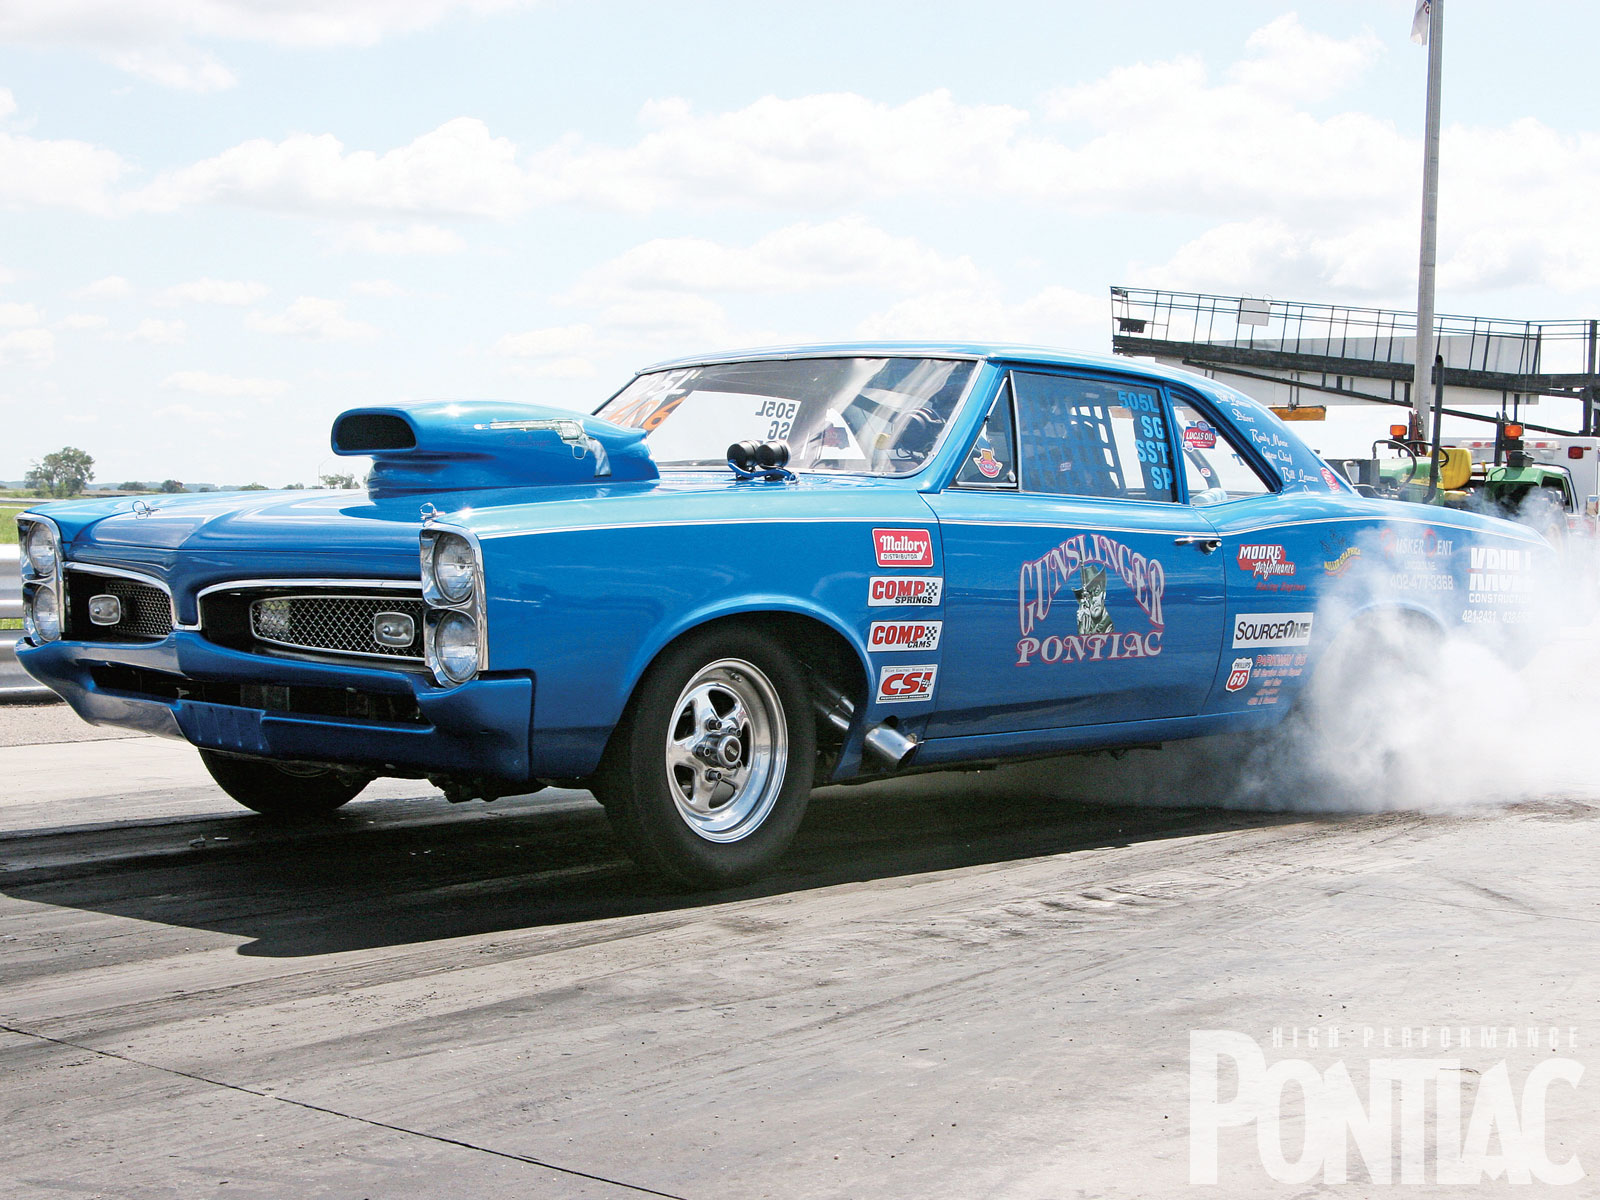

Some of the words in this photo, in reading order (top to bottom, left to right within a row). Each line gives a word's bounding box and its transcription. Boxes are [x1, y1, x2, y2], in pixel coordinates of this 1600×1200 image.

[1118, 390, 1159, 413] 505L
[1141, 415, 1165, 439] SG
[1186, 432, 1204, 440] LUCAS
[1205, 433, 1214, 441] OIL
[1135, 440, 1169, 464] SST
[880, 535, 927, 553] Mallory
[1239, 546, 1282, 561] MOORE
[872, 581, 925, 600] COMP
[1019, 534, 1165, 637] GUNSLINGER
[895, 596, 933, 604] SPRINGS
[872, 625, 925, 645] COMP
[907, 640, 931, 648] CAMS
[1015, 630, 1164, 667] PONTIAC
[881, 672, 933, 695] CSI
[1230, 672, 1246, 686] 66
